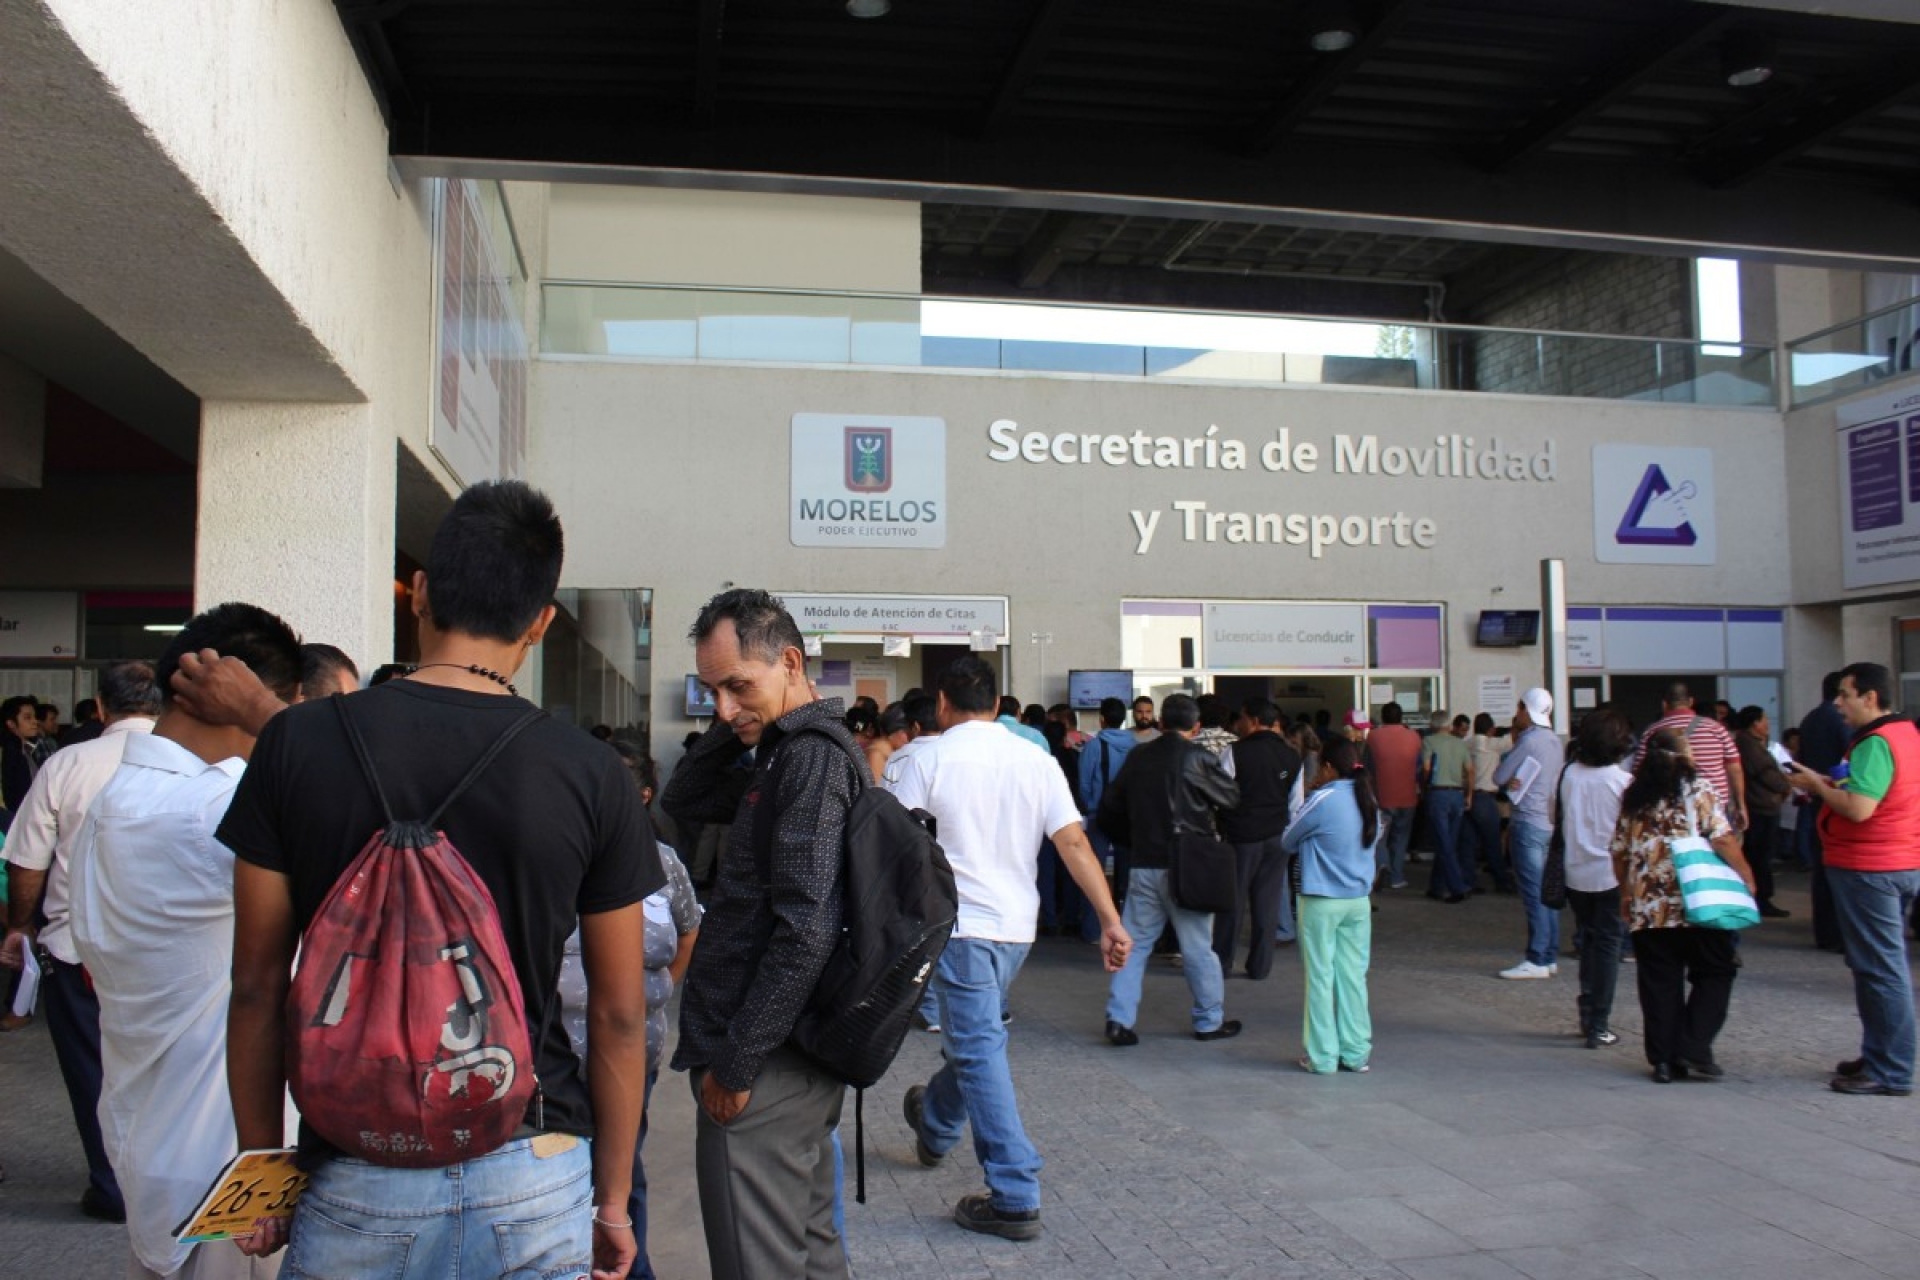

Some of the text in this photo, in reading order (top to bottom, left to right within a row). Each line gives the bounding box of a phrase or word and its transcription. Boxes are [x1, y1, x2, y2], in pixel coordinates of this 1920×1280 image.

[987, 419, 1558, 481] Secretaría de Movilidad
[800, 498, 937, 523] MORELOS
[818, 525, 918, 537] PODER EJECUTIVO
[1130, 500, 1438, 558] y Transporte
[804, 605, 976, 620] Módulo de Atención de Citas
[1215, 629, 1355, 644] Licencias de Conducir
